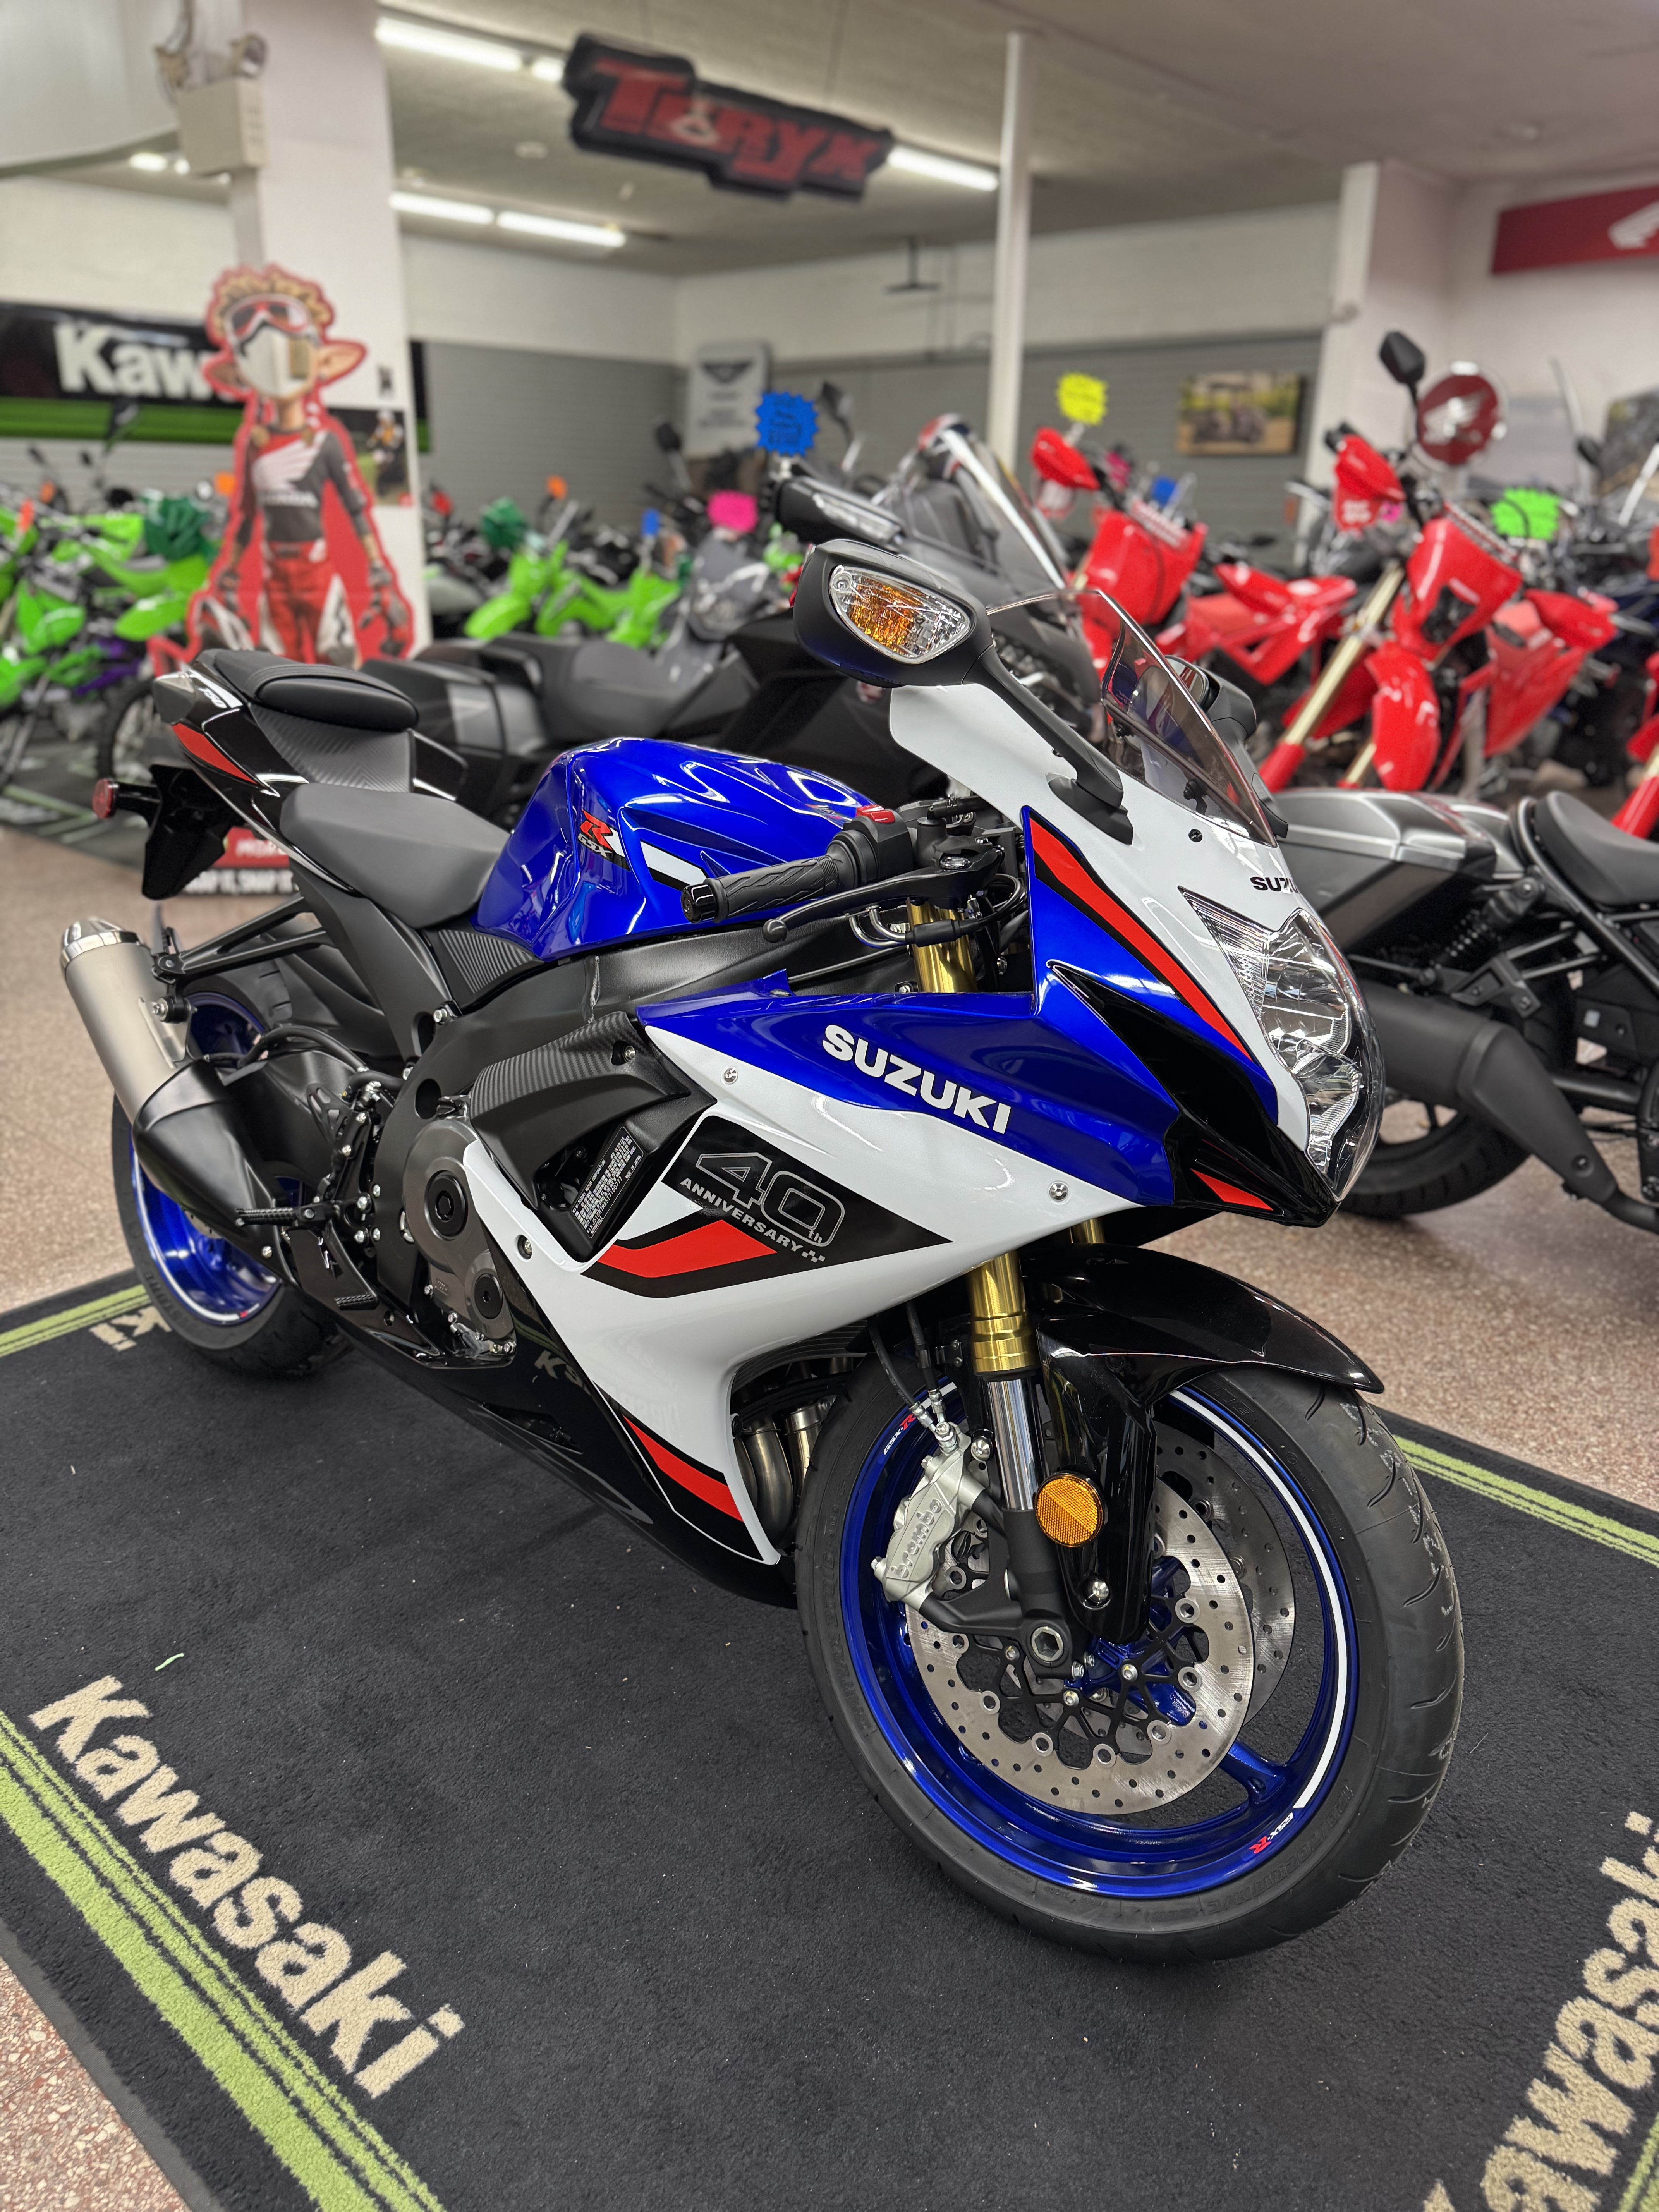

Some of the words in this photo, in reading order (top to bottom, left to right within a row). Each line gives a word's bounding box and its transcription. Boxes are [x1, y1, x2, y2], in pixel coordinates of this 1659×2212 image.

[198, 687, 227, 708] 750
[577, 833, 612, 858] GSX
[822, 1025, 1011, 1134] SUZUKI
[680, 1178, 804, 1252] ANNIVERSARY
[891, 1498, 942, 1578] brembo
[28, 1675, 465, 2099] Kawasaki
